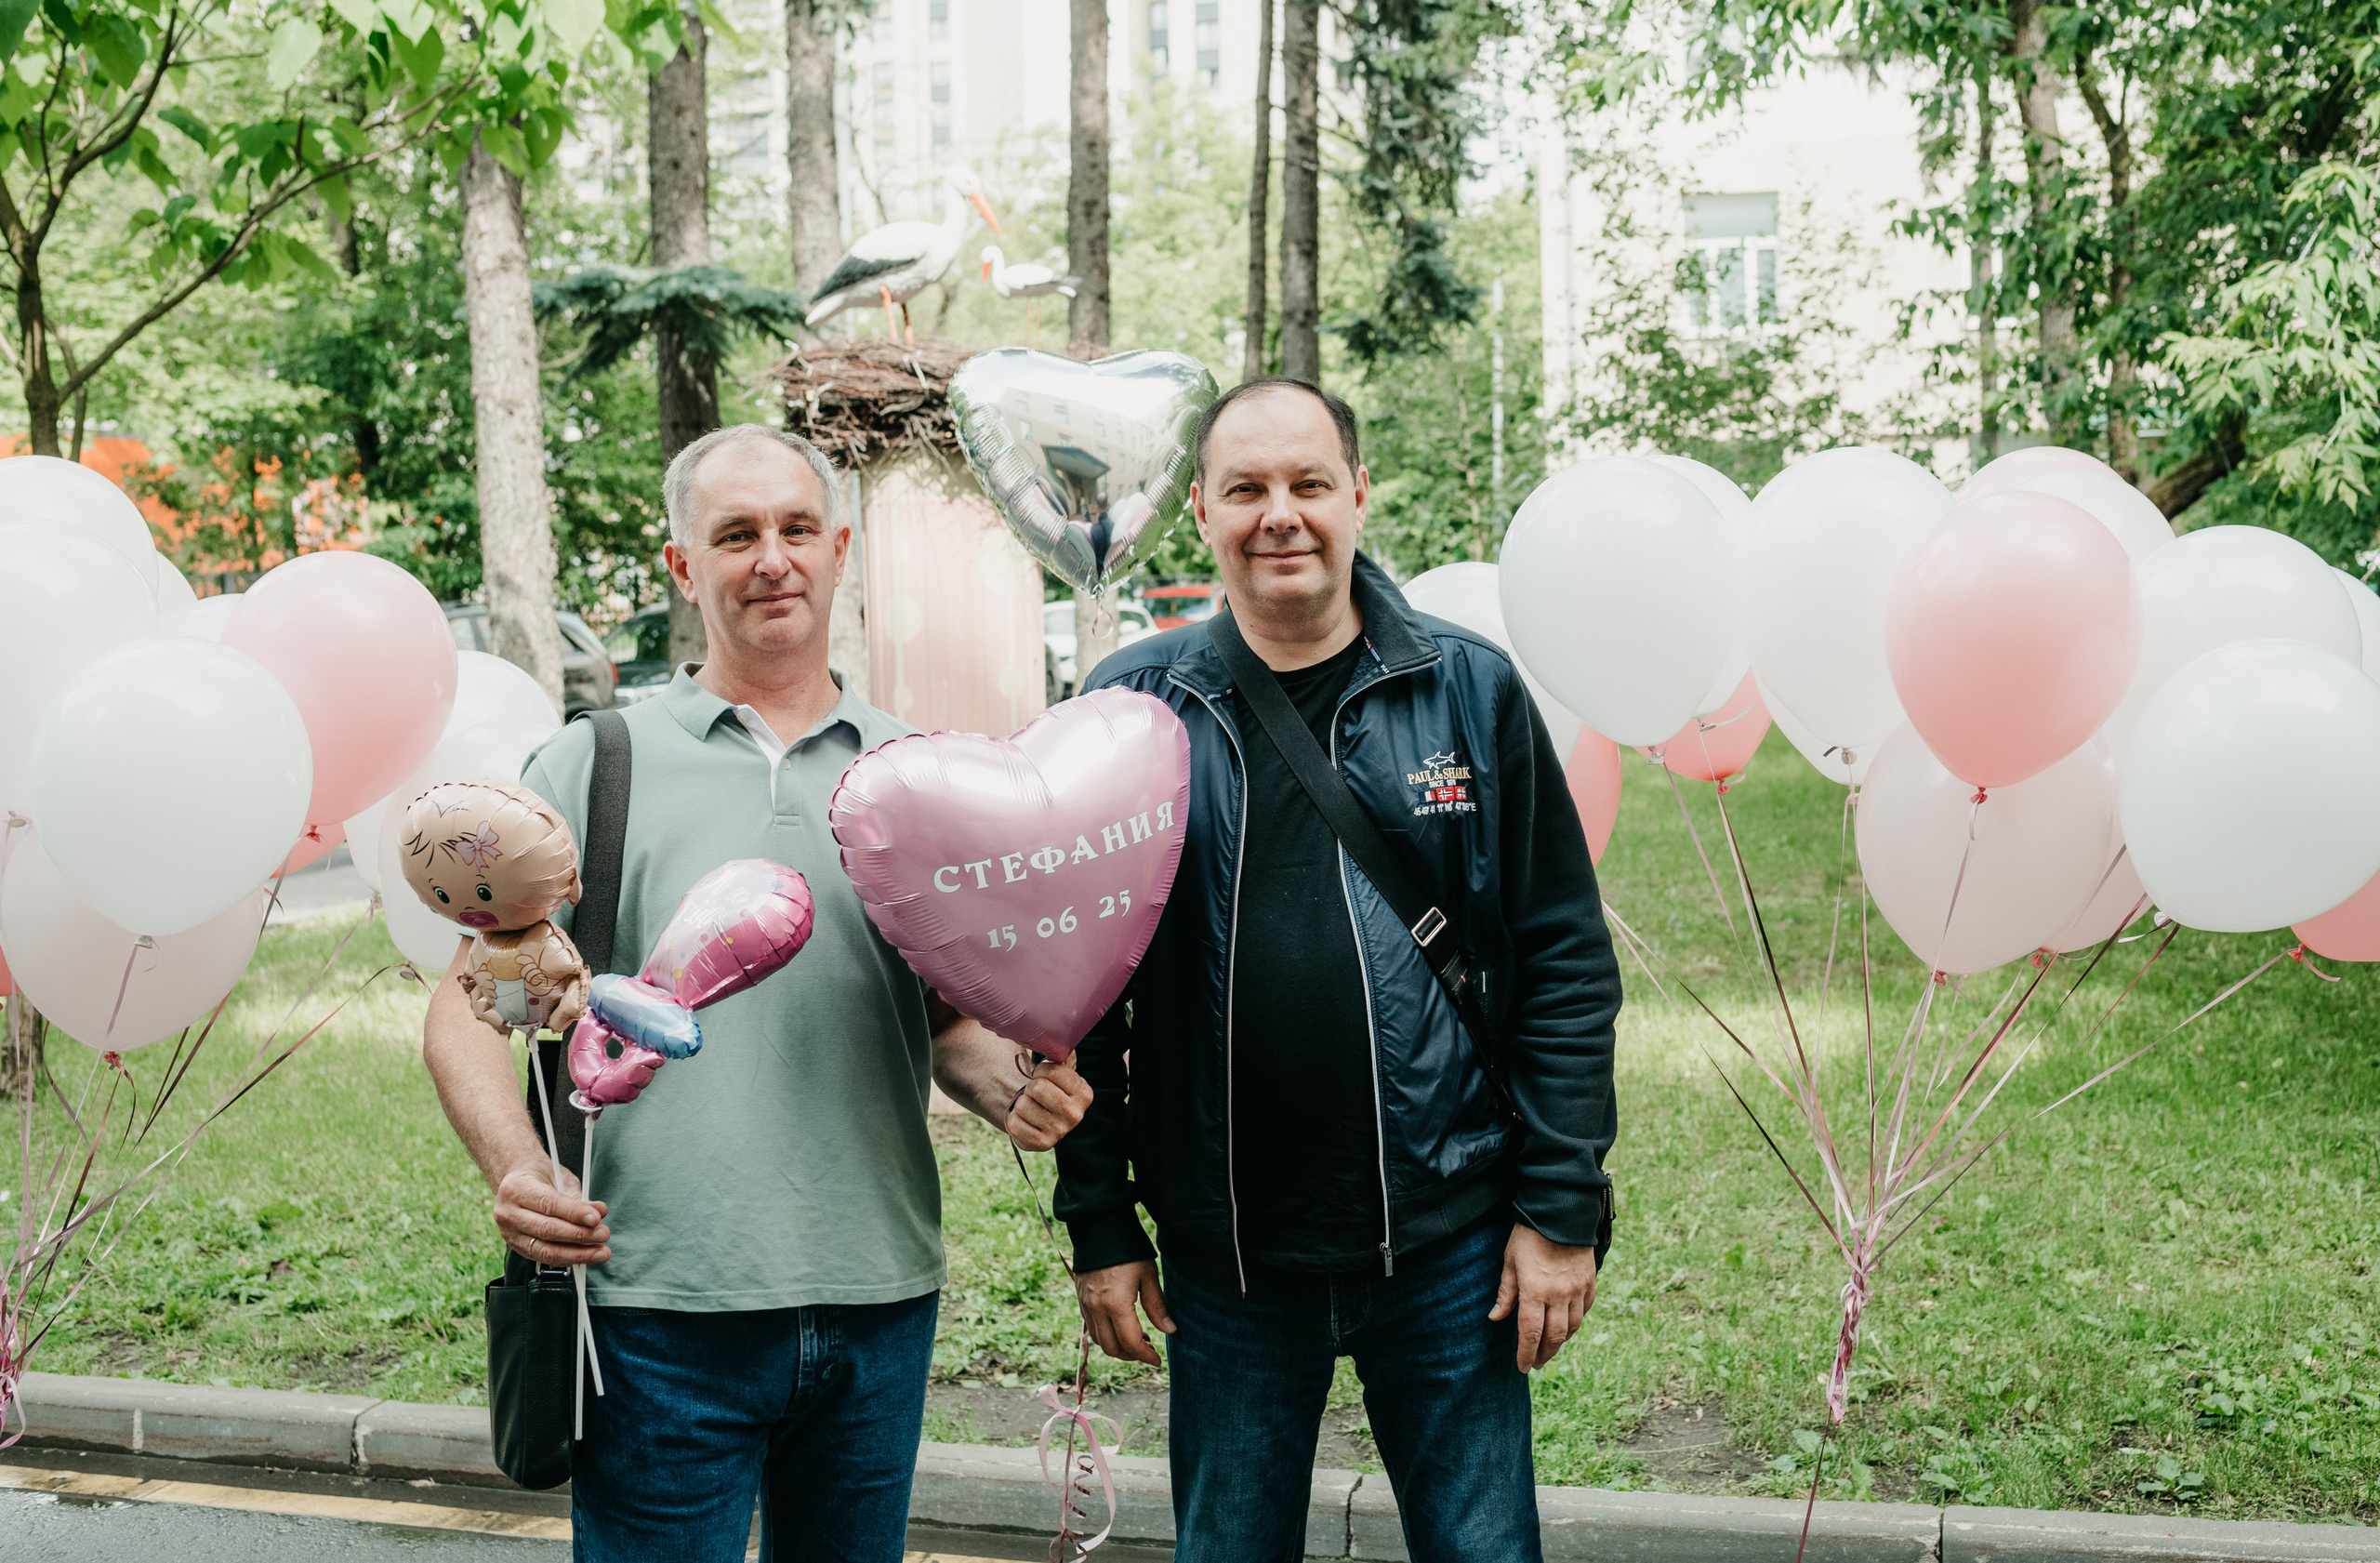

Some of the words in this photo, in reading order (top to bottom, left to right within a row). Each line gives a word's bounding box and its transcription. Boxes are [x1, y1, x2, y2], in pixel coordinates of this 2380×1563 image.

[1407, 770, 1434, 785] PAUL
[1434, 770, 1443, 780] &
[1442, 767, 1472, 779] SHARK
[1429, 779, 1444, 788] SINCE
[933, 801, 1174, 893] СТЕФАНИЯ
[986, 924, 1018, 952] 15
[1037, 907, 1078, 938] 06
[1099, 889, 1131, 919] 25
